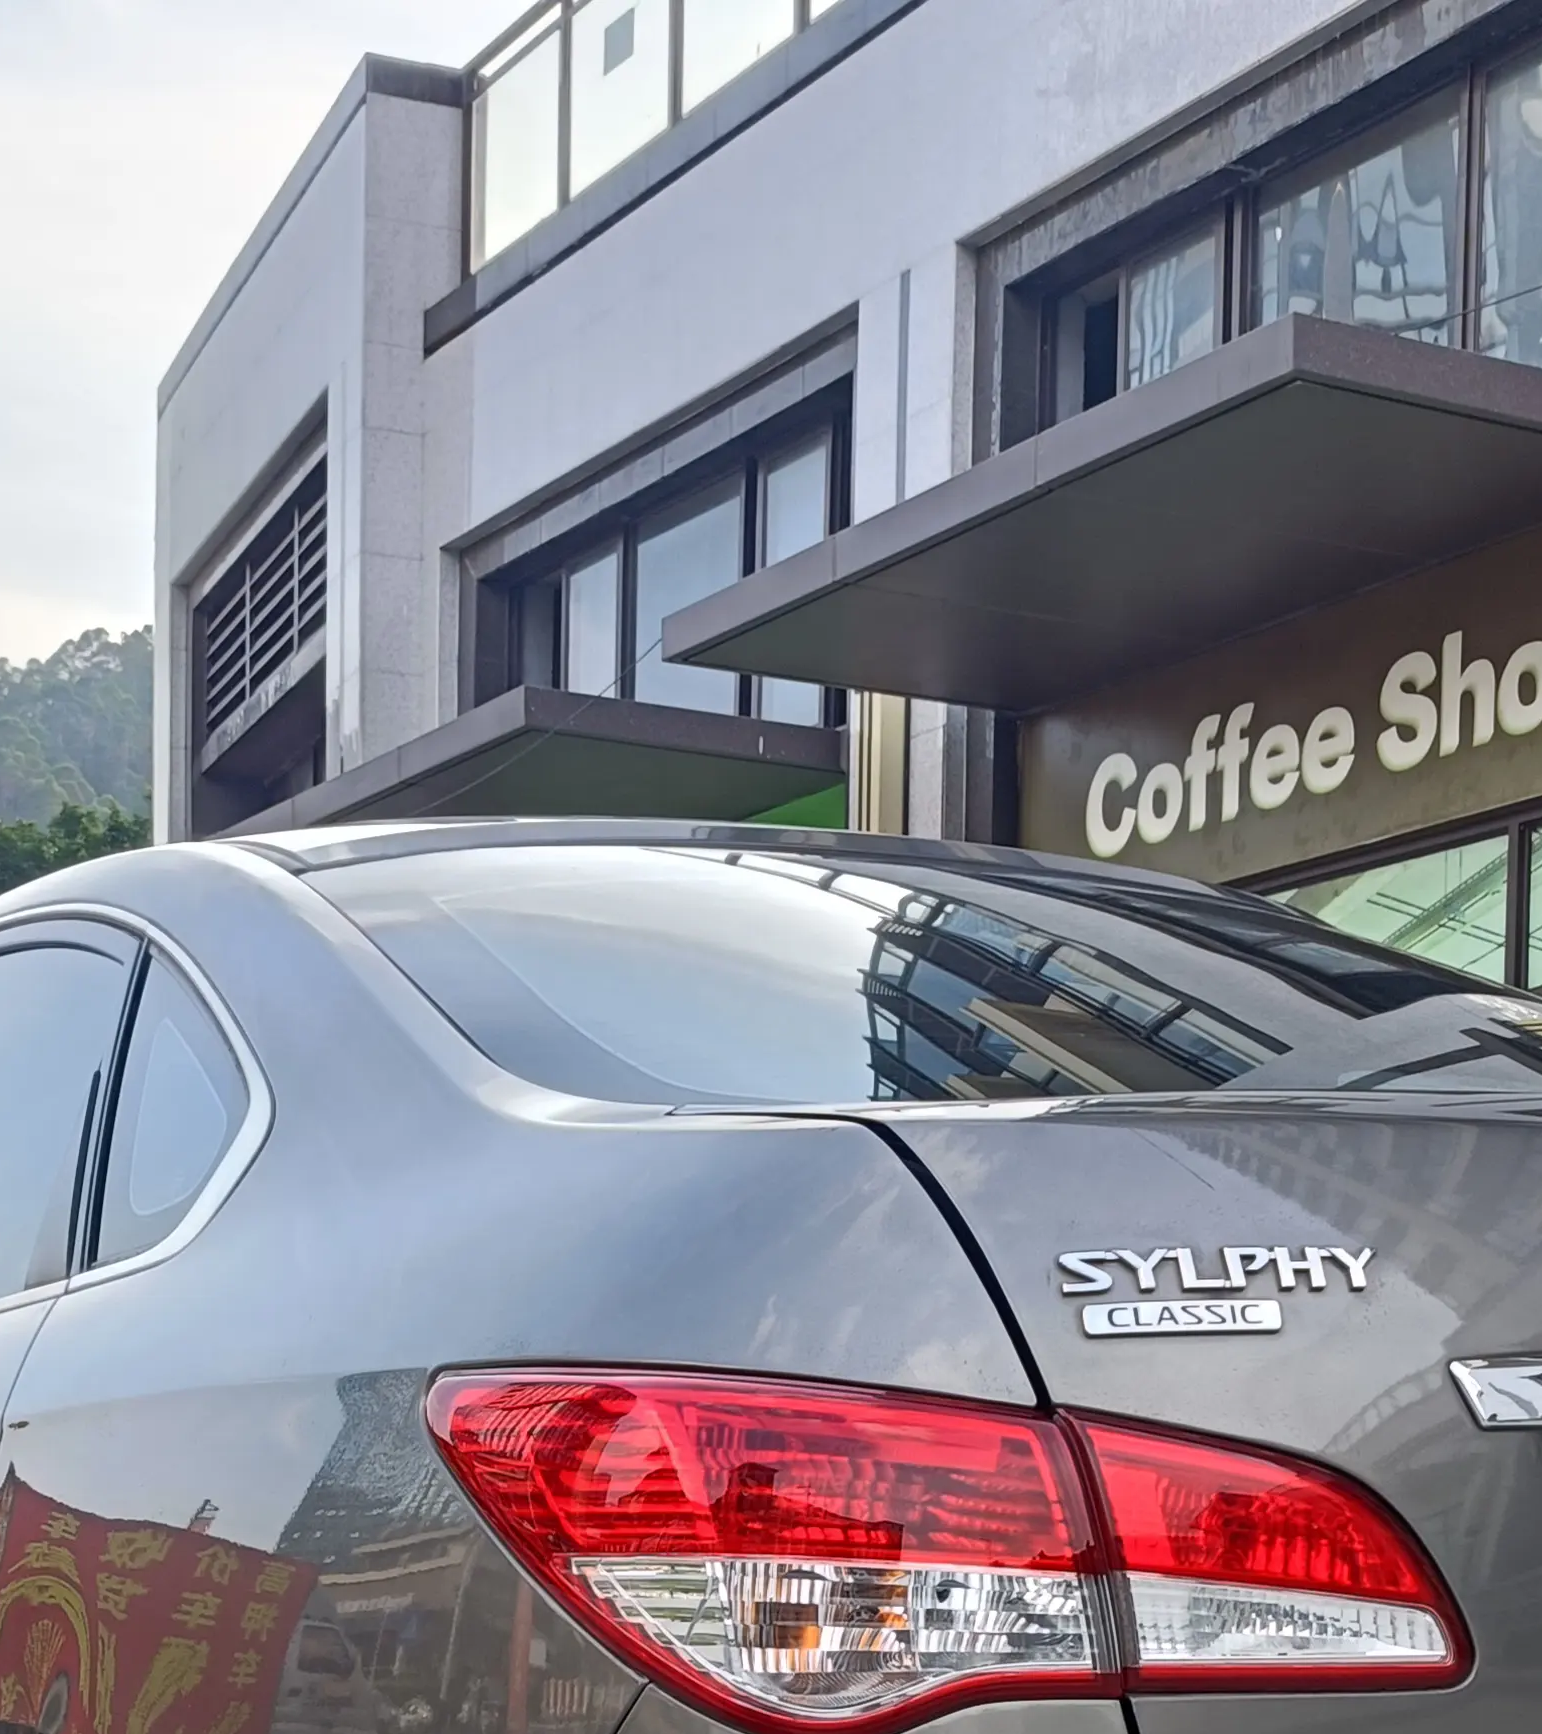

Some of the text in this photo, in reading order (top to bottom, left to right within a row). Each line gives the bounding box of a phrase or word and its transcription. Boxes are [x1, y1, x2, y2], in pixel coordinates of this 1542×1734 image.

[1086, 702, 1355, 858] Coffee
[1056, 1246, 1376, 1294] SYLPHY
[1106, 1303, 1265, 1329] CLASSIC
